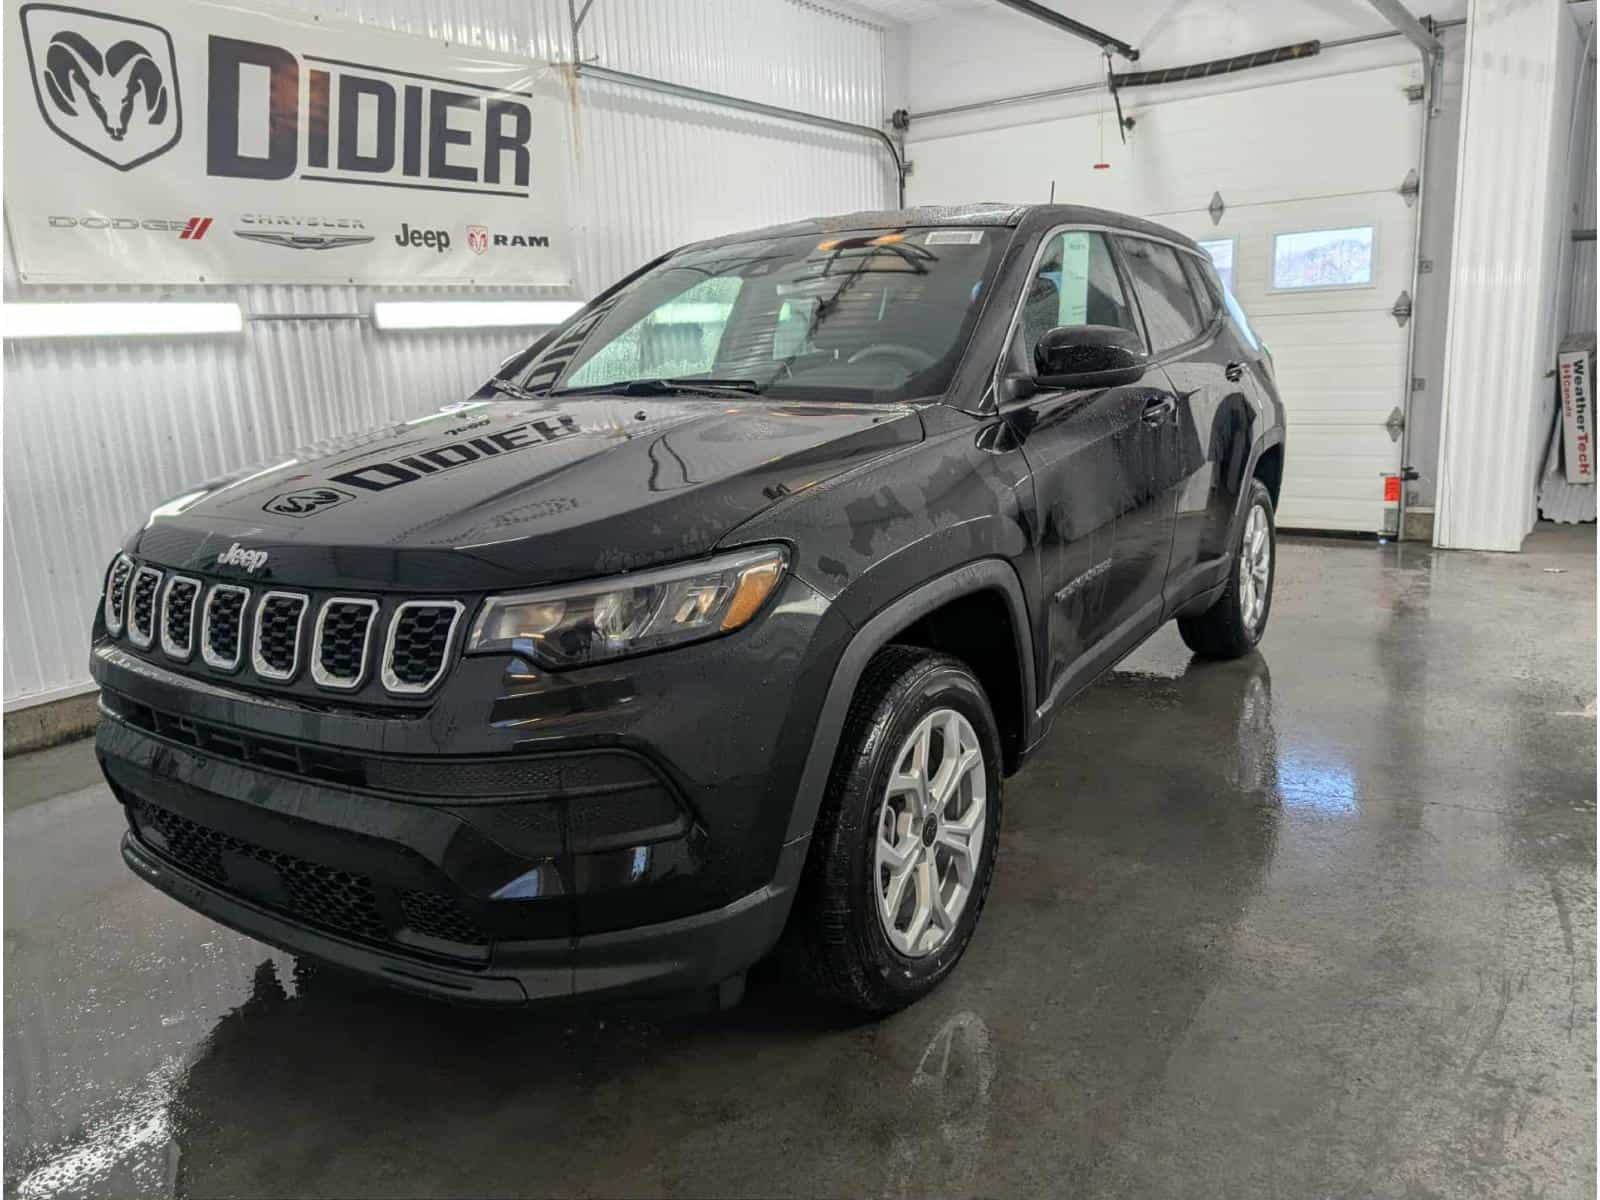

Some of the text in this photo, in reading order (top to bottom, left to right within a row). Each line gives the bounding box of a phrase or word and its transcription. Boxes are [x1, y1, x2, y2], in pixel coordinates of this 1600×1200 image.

[206, 34, 532, 187] DIDIER
[48, 215, 193, 232] DODGE
[240, 213, 365, 229] CHRYSLER
[395, 223, 450, 253] Jeep
[493, 234, 550, 248] RAM
[1573, 359, 1589, 475] WeatherTech
[217, 542, 268, 573] Jeep
